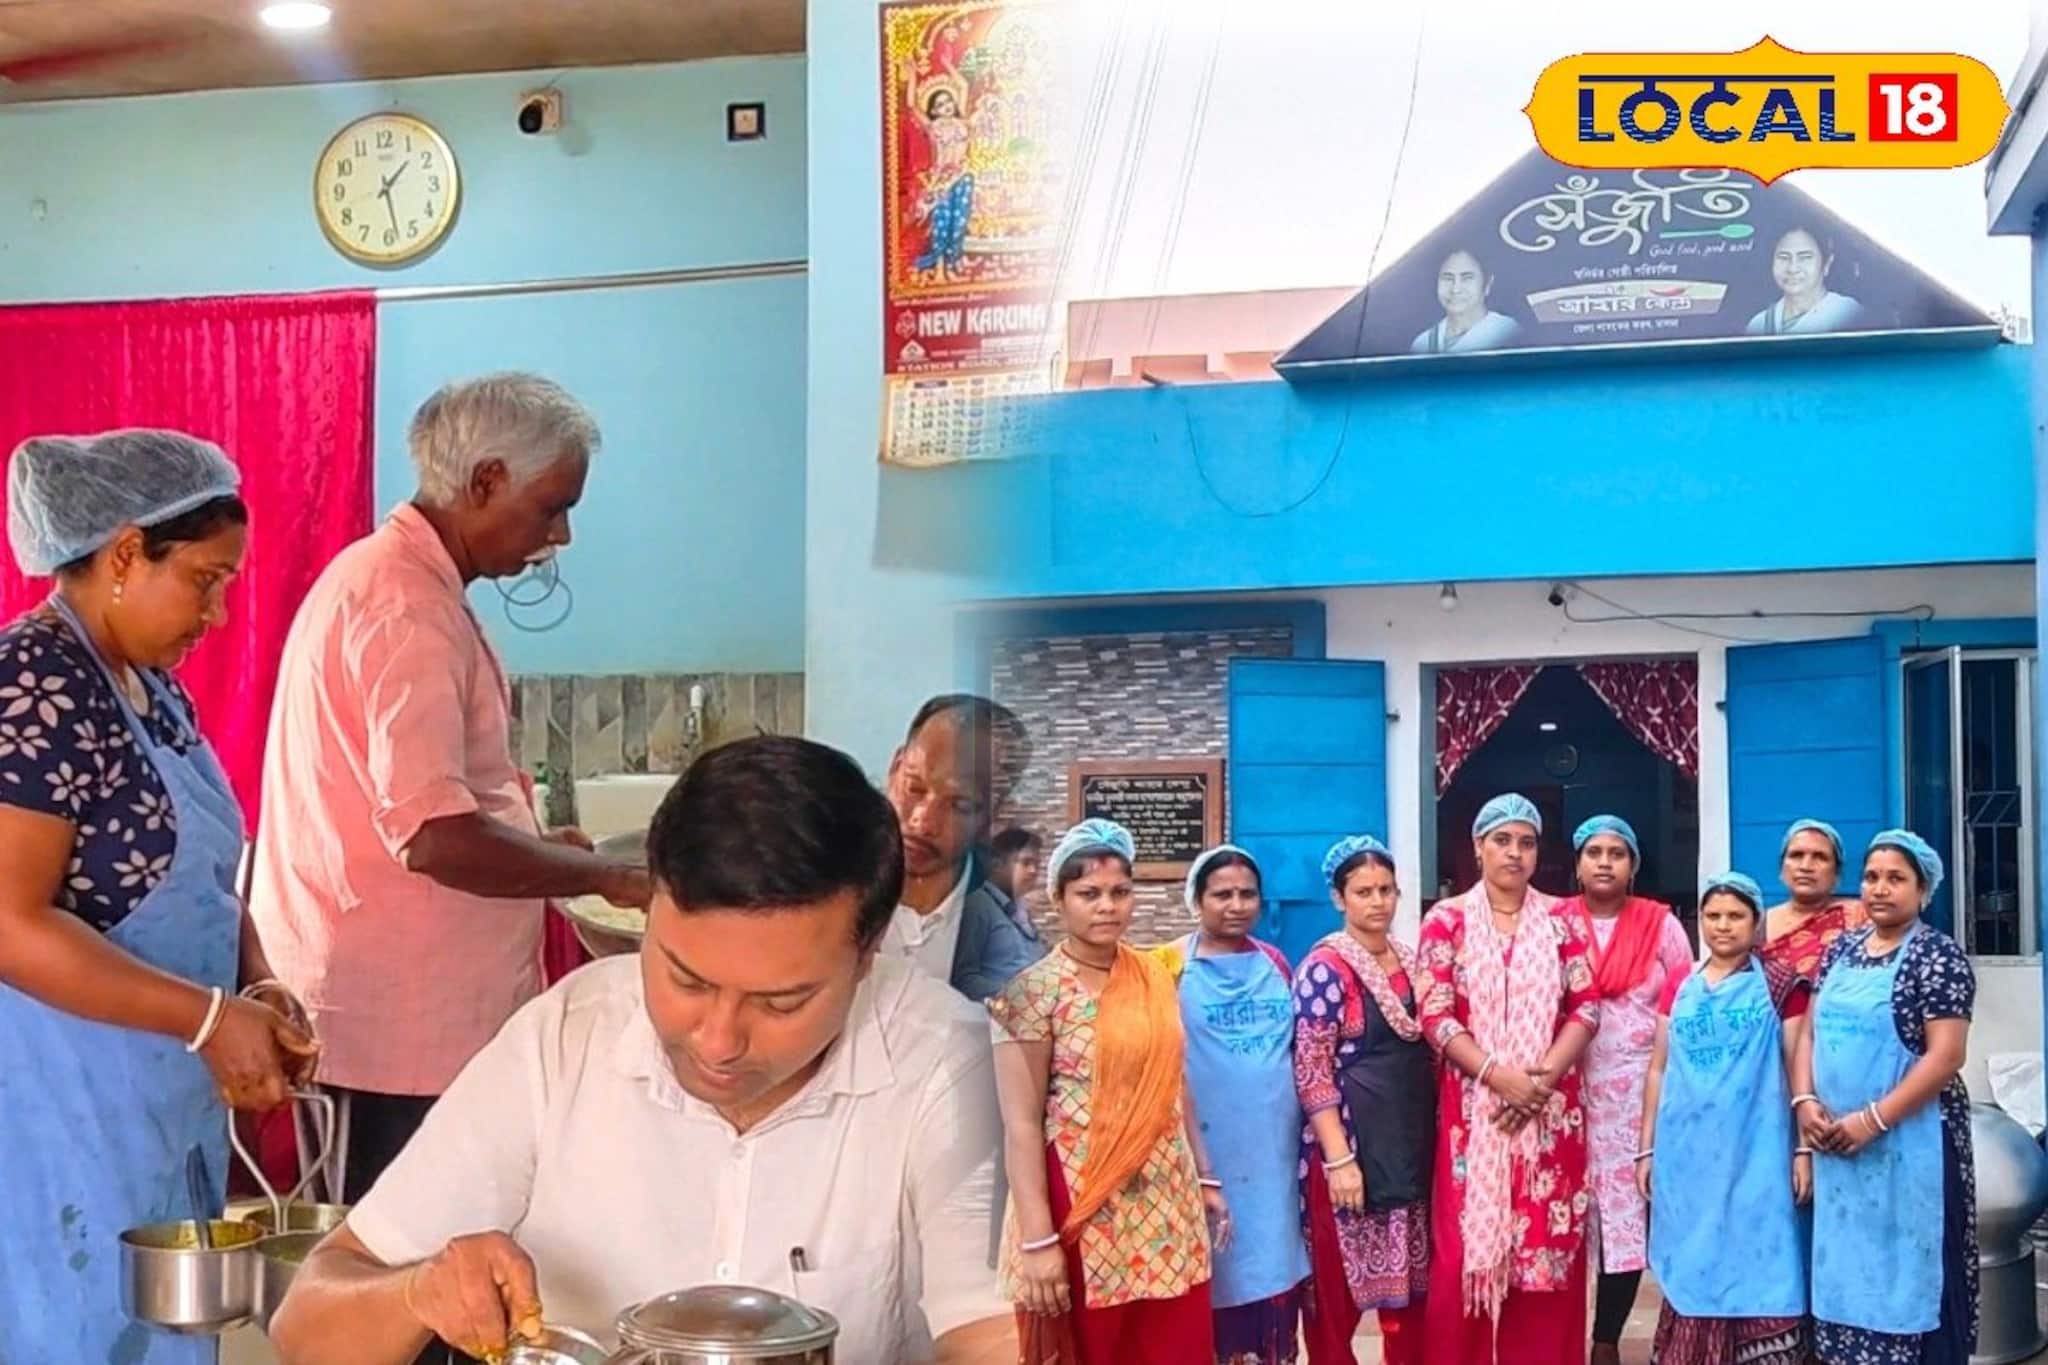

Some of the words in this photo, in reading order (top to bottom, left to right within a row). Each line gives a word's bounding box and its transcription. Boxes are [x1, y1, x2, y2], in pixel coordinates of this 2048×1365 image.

[376, 130, 393, 148] 12
[405, 136, 411, 152] 1
[355, 140, 367, 157] 11
[337, 159, 352, 177] 10
[421, 152, 432, 169] 2
[428, 176, 440, 192] 3
[334, 184, 345, 202] 9
[341, 208, 352, 225] 8
[424, 200, 434, 218] 4
[360, 225, 370, 242] 7
[383, 228, 394, 246] 6
[407, 220, 418, 238] 5
[1649, 242, 1674, 256] Good
[918, 309, 962, 338] NEW
